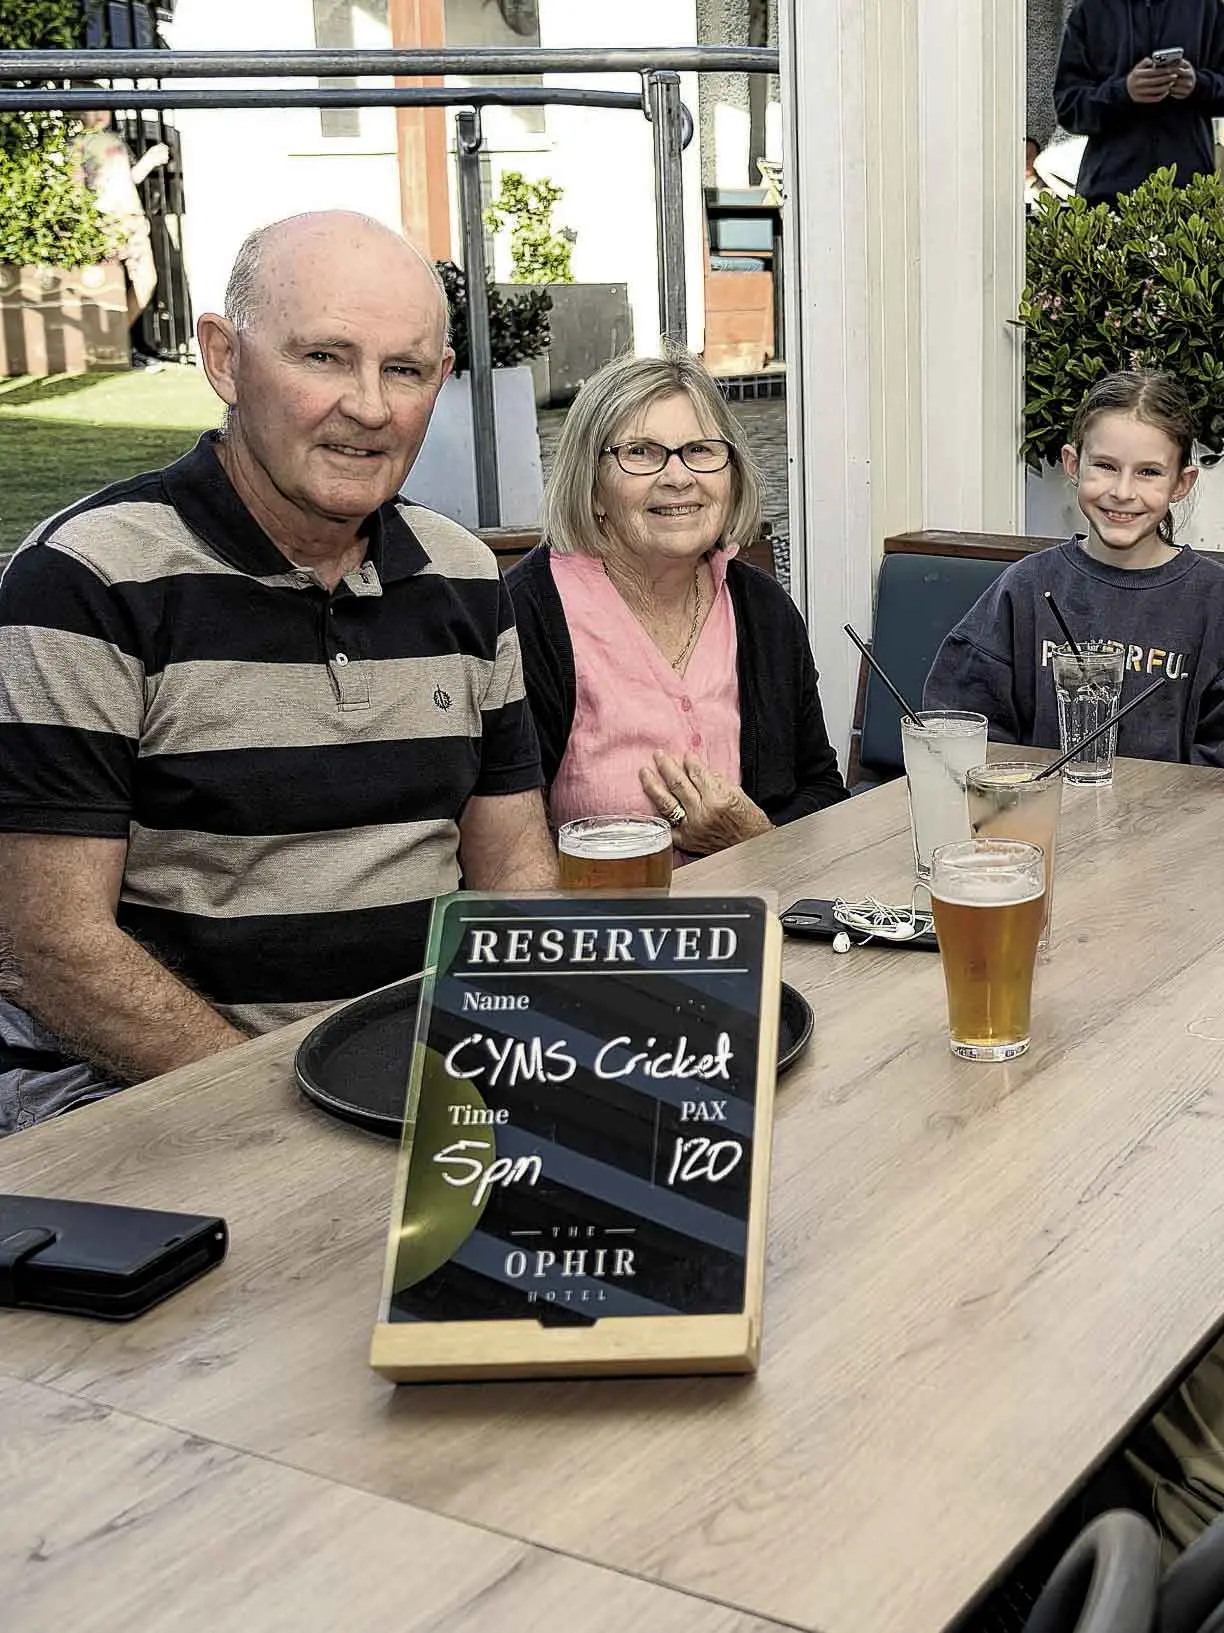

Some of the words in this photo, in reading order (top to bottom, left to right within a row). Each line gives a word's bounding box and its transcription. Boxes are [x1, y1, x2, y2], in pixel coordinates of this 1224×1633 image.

[466, 925, 739, 966] RESERVED
[461, 991, 530, 1012] Name
[443, 1032, 577, 1087] CYMS
[593, 1032, 735, 1082] Cricket
[447, 1104, 511, 1126] Time
[680, 1100, 728, 1121] PAX
[432, 1139, 543, 1208] 5pm
[667, 1136, 745, 1185] 120
[551, 1225, 596, 1238] THE
[503, 1248, 638, 1279] OPHIR
[527, 1289, 608, 1302] HOTEL
